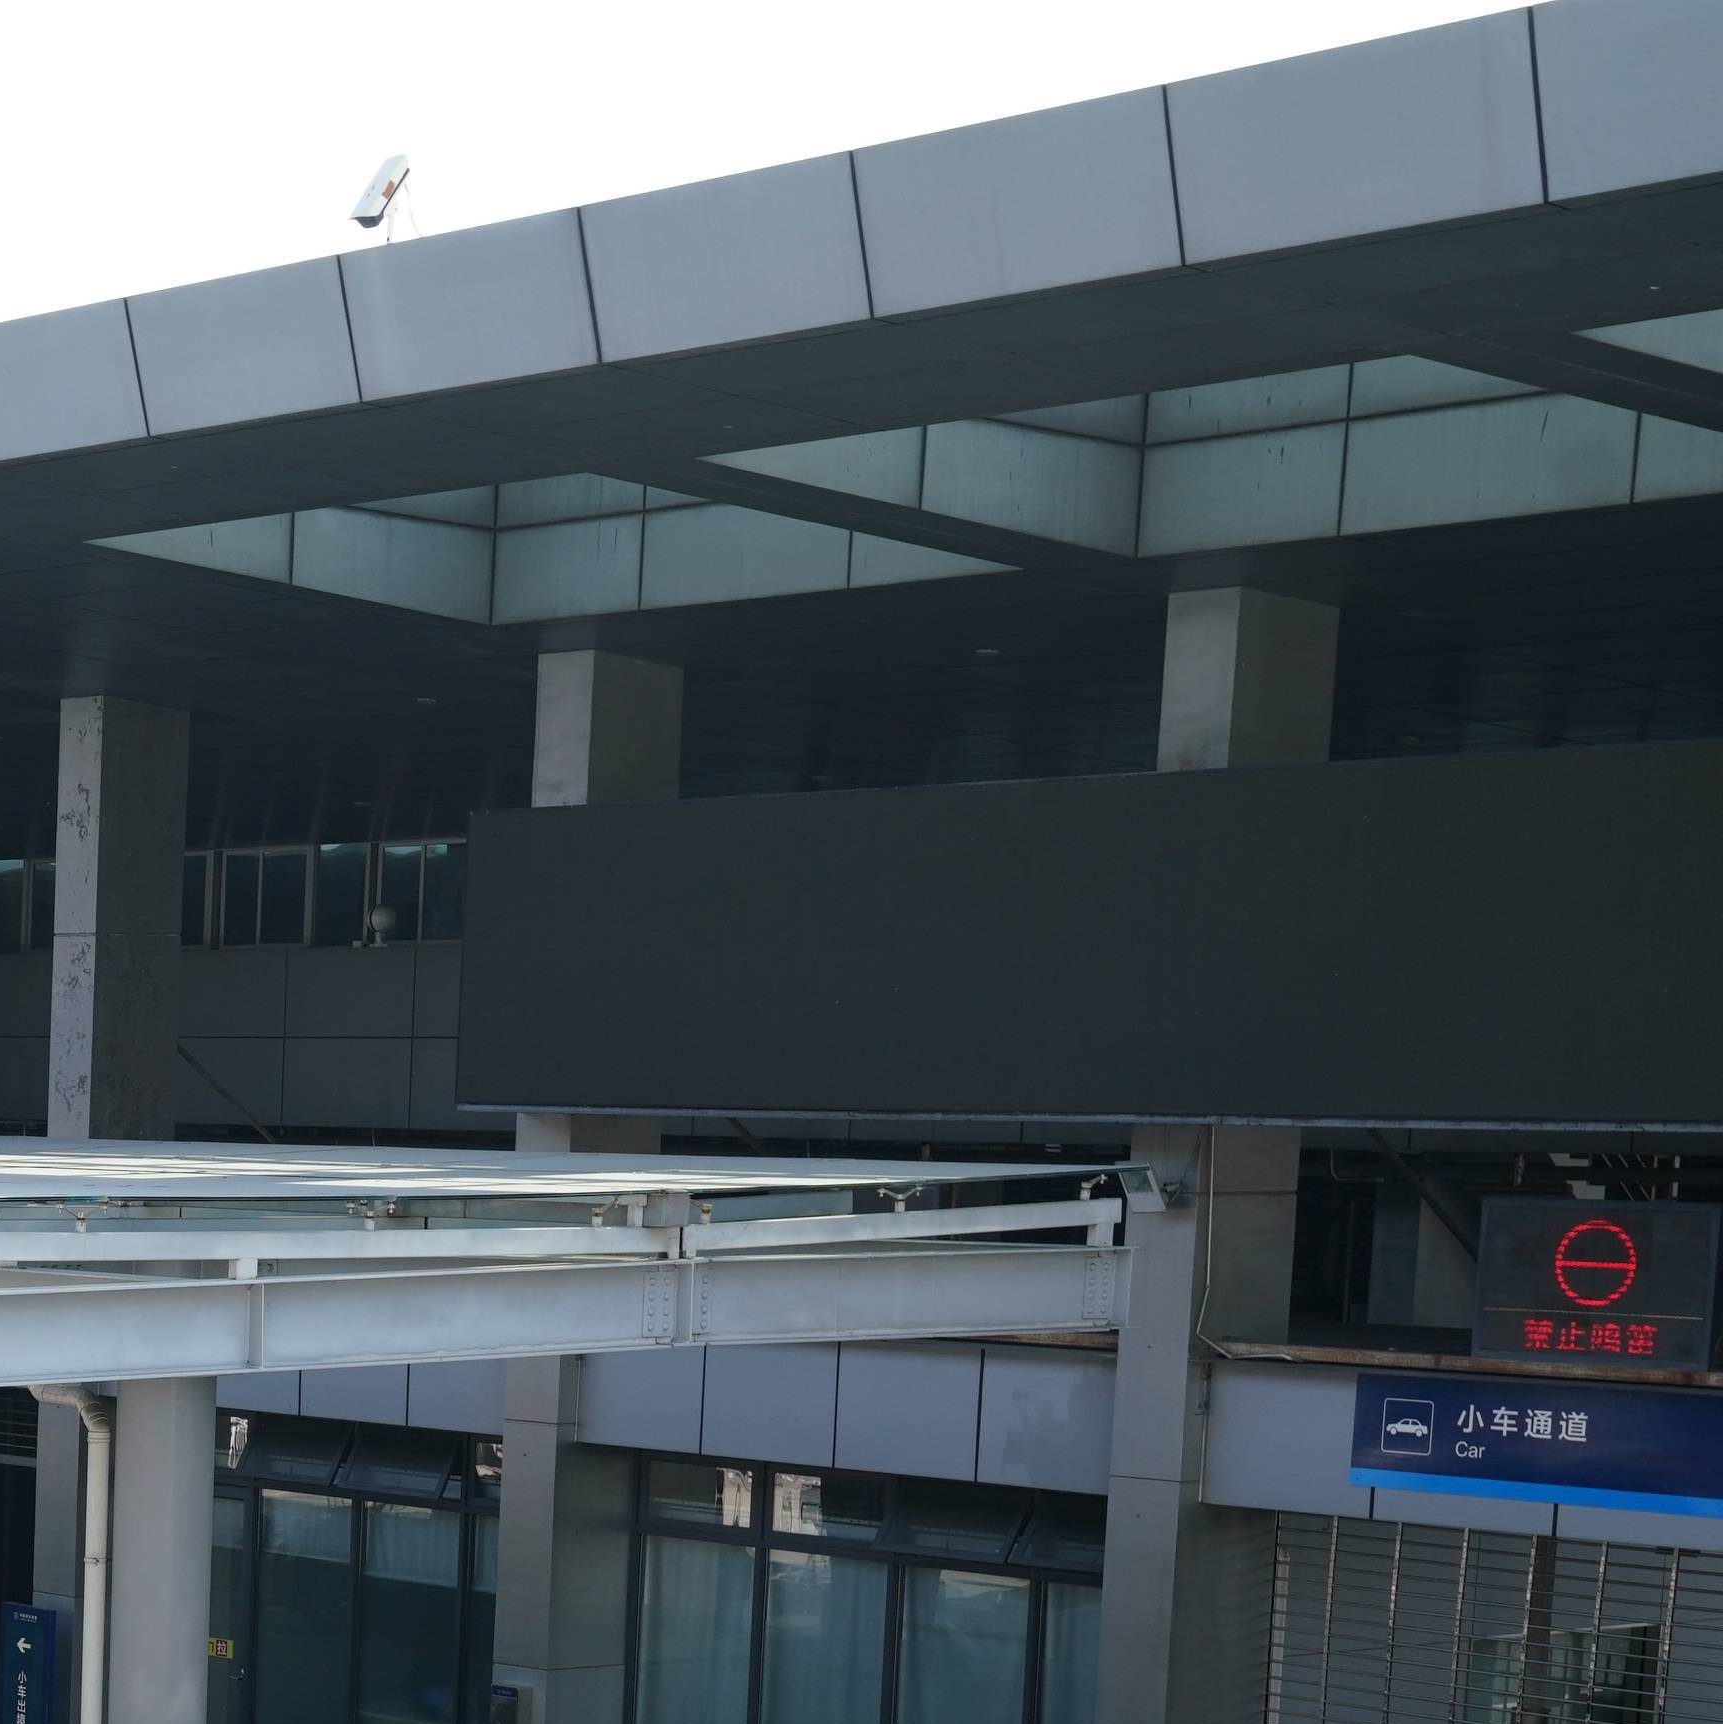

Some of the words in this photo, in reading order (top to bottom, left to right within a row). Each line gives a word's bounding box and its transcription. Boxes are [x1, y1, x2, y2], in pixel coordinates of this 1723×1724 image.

[1523, 1319, 1658, 1355] 禁止鸣笛
[1456, 1404, 1589, 1443] 小车通道
[1455, 1441, 1486, 1459] Car
